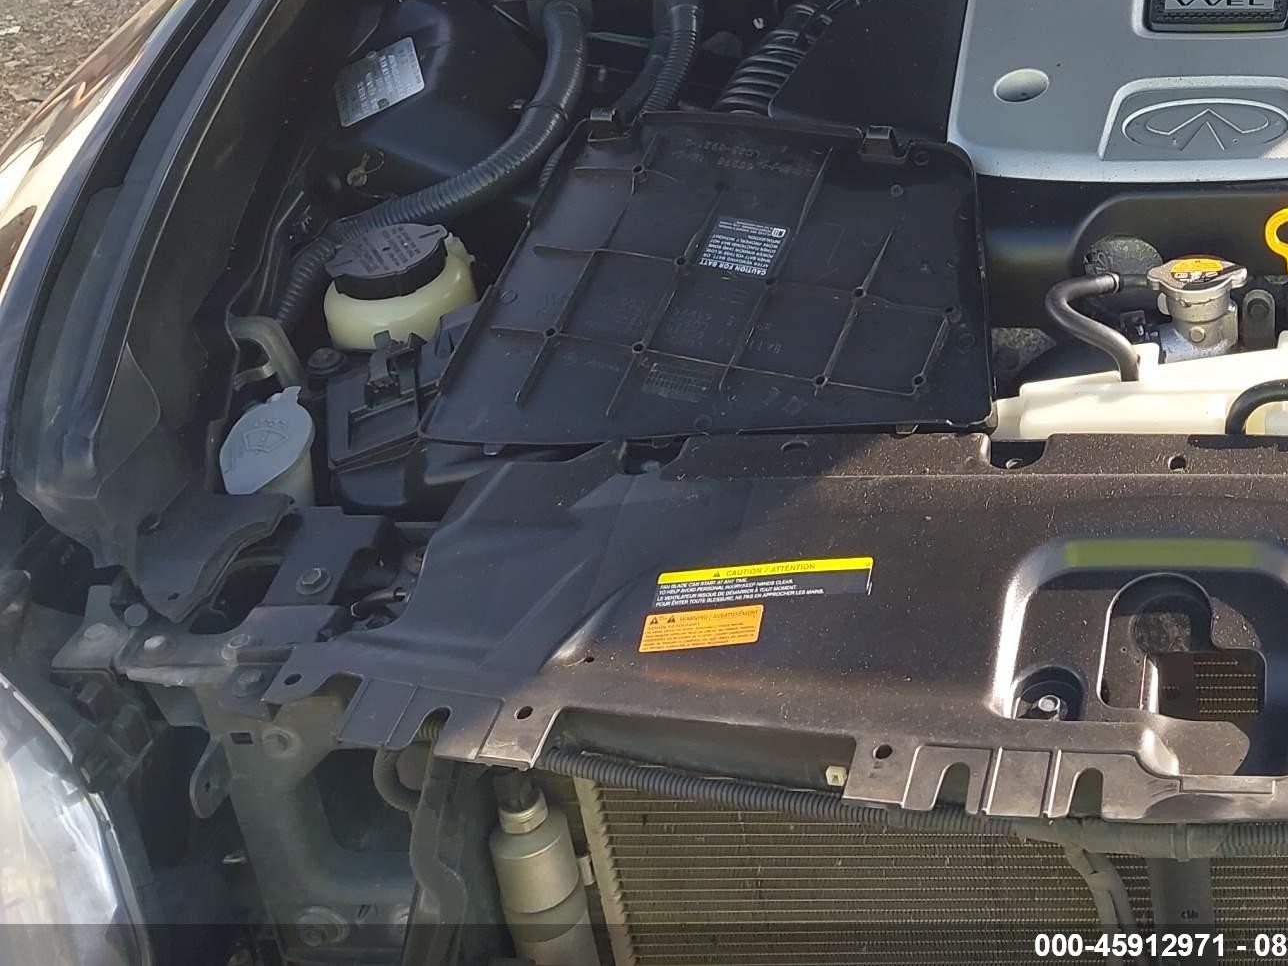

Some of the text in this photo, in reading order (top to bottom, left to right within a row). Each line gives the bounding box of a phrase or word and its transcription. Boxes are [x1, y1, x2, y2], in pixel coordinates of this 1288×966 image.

[699, 257, 766, 276] CAUTION FOR BATT
[726, 568, 762, 577] CAUTION
[771, 563, 815, 573] ATTENTION
